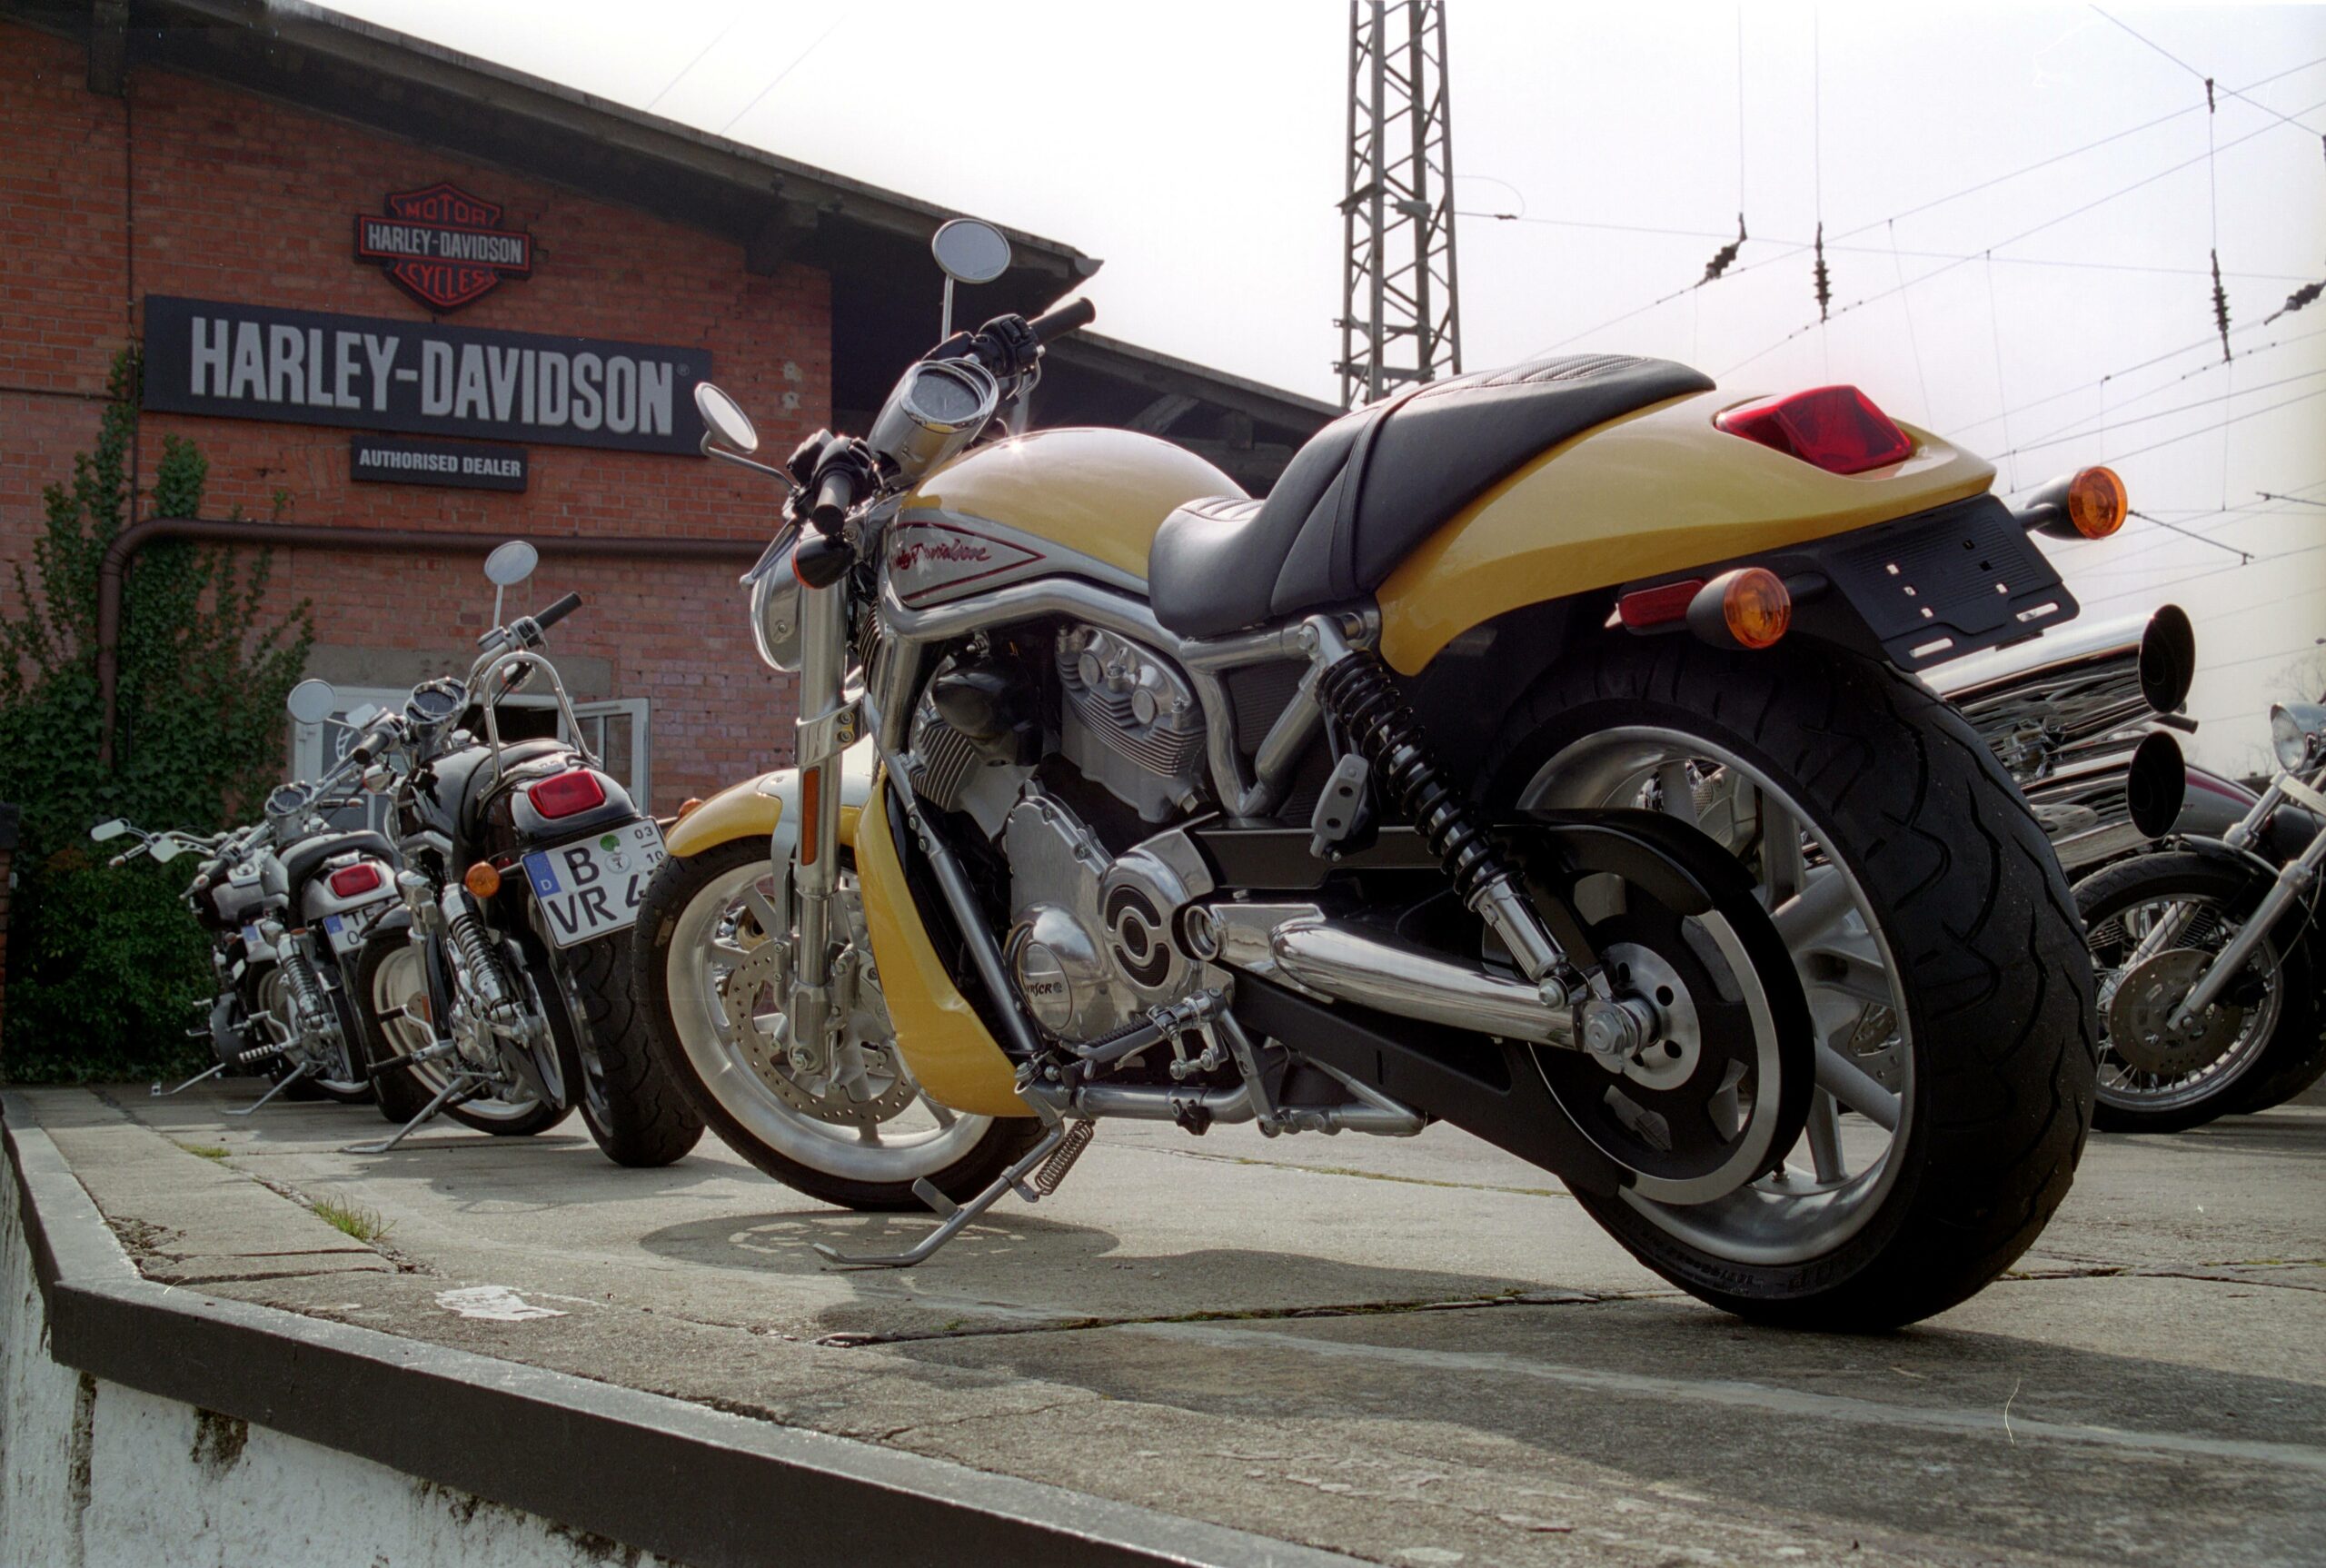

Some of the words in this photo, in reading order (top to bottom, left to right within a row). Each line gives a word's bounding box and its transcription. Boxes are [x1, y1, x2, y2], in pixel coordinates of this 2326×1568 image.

[405, 194, 488, 226] MOTOR
[367, 223, 522, 264] HARLEY-DAVIDSON
[405, 263, 483, 300] CYCLES
[191, 316, 673, 436] HARLEY-DAVIDSON
[359, 448, 459, 472] AUTHORISED
[462, 456, 522, 478] DEALER
[633, 826, 654, 840] 03
[563, 847, 601, 887] B
[646, 849, 664, 864] 10
[540, 878, 553, 891] D
[547, 885, 619, 935] VR
[625, 868, 655, 908] 4
